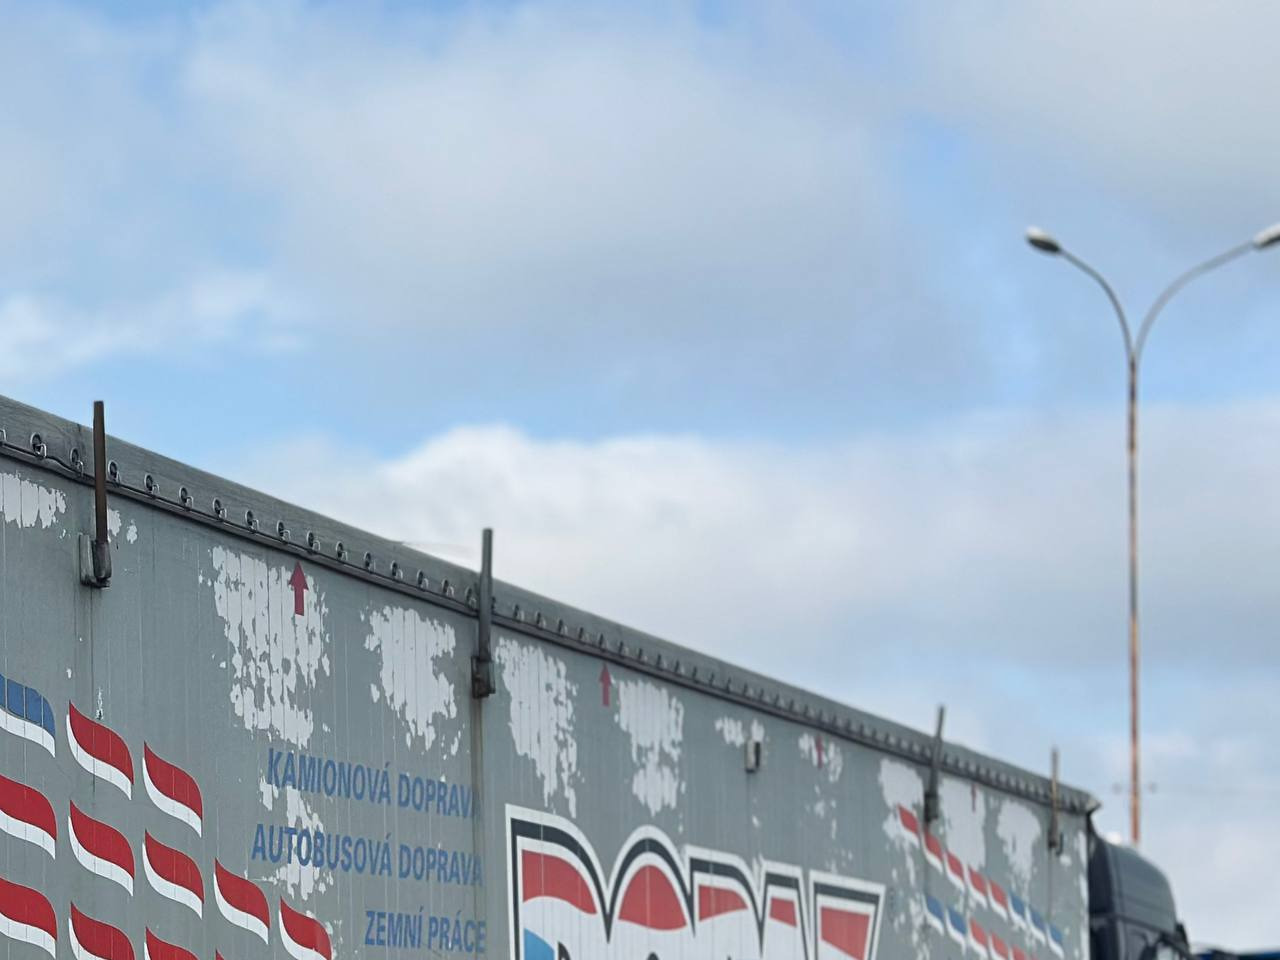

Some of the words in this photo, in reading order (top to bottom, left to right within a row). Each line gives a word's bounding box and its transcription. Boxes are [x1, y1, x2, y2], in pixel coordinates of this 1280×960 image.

[267, 748, 391, 804] KAMIONOVÁ
[252, 823, 392, 877] AUTOBUSOVÁ
[399, 844, 483, 887] DOPRAVA
[365, 906, 423, 949] ZEMNÍ
[428, 911, 486, 953] PRÁCE
